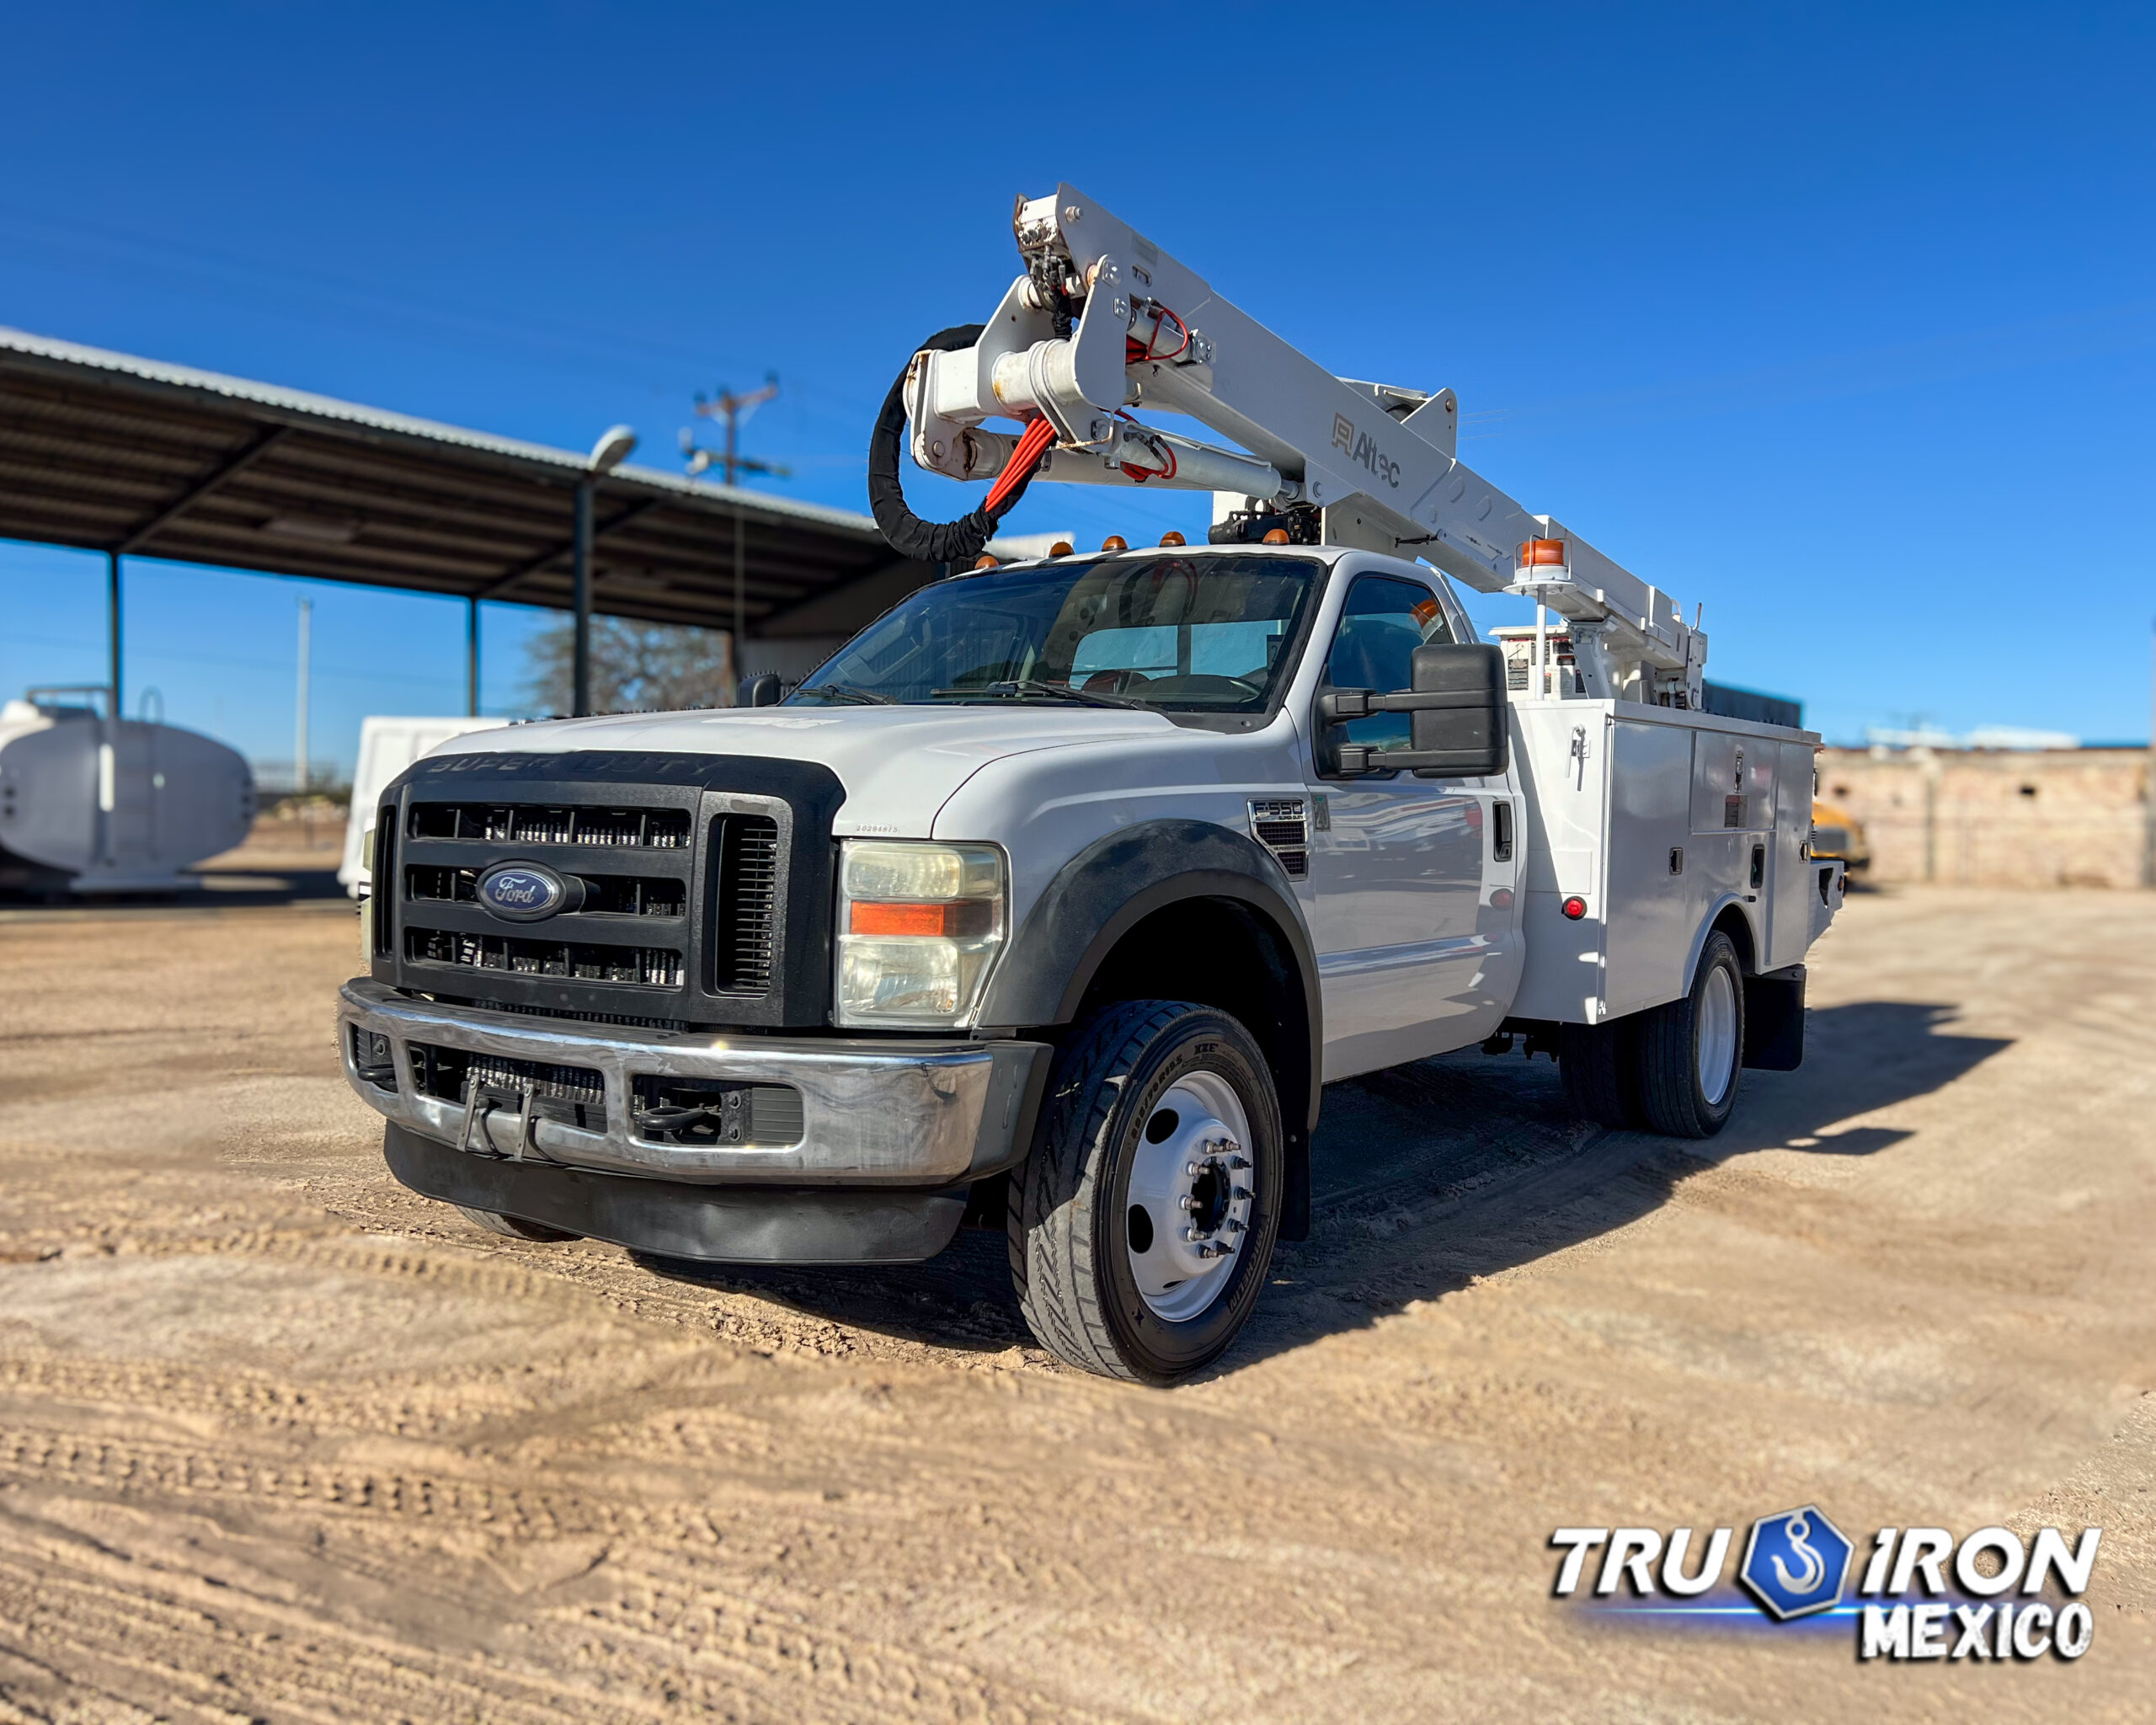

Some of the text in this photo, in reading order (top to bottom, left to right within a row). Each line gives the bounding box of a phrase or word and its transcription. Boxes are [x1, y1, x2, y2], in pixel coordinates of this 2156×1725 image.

[1352, 430, 1401, 489] Altec
[426, 756, 725, 776] SUPER DUTY
[494, 876, 536, 904] Ford
